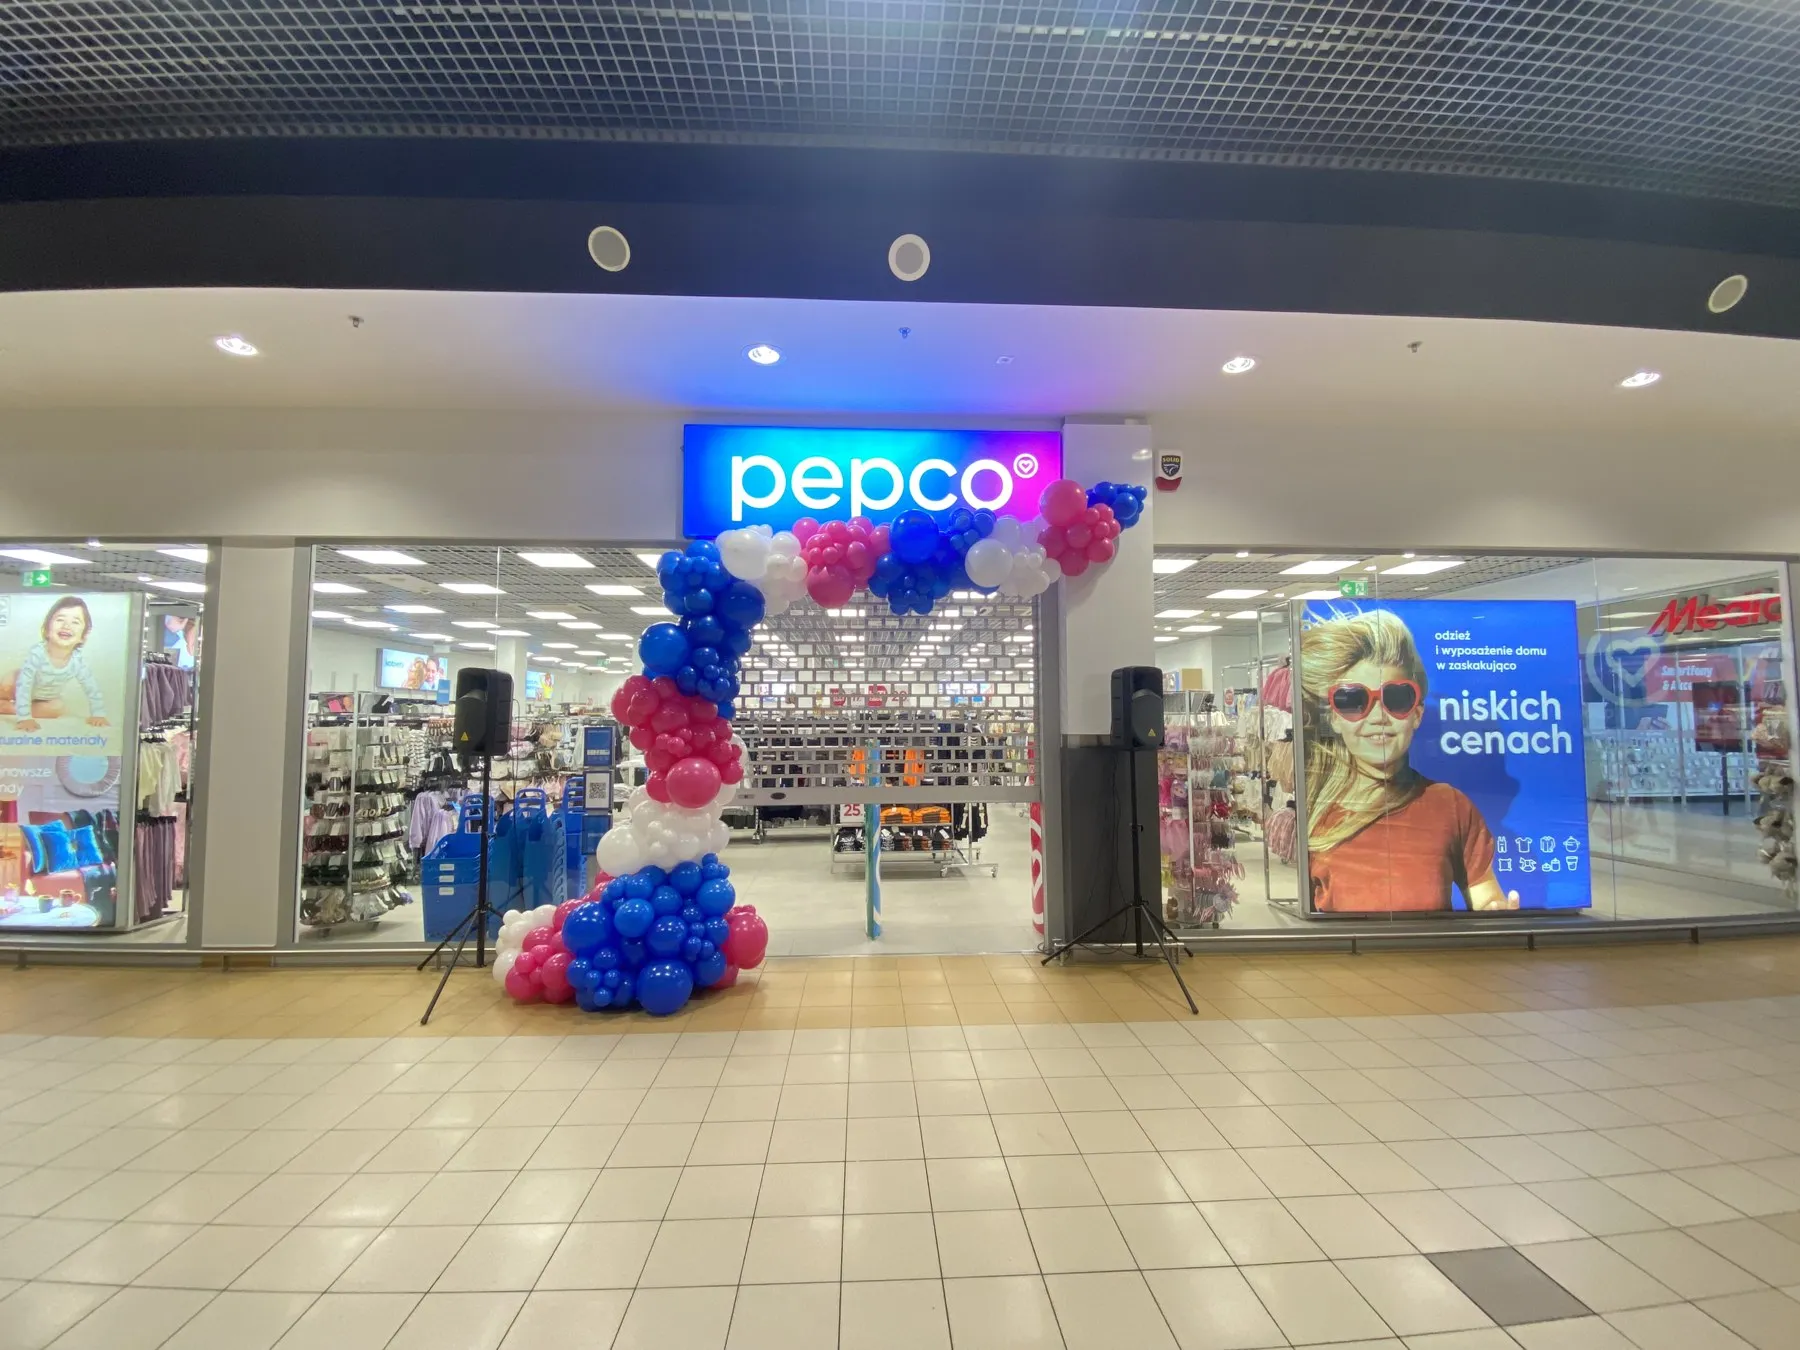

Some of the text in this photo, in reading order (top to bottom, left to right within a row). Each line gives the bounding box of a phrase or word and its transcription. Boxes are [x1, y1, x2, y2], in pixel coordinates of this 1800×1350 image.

[732, 455, 1013, 521] pepco
[1434, 630, 1471, 641] odzież
[1435, 645, 1547, 658] i wyposażenie domu
[1436, 660, 1517, 673] w zaskakująco
[1439, 689, 1561, 721] niskich
[1440, 723, 1573, 755] cenach
